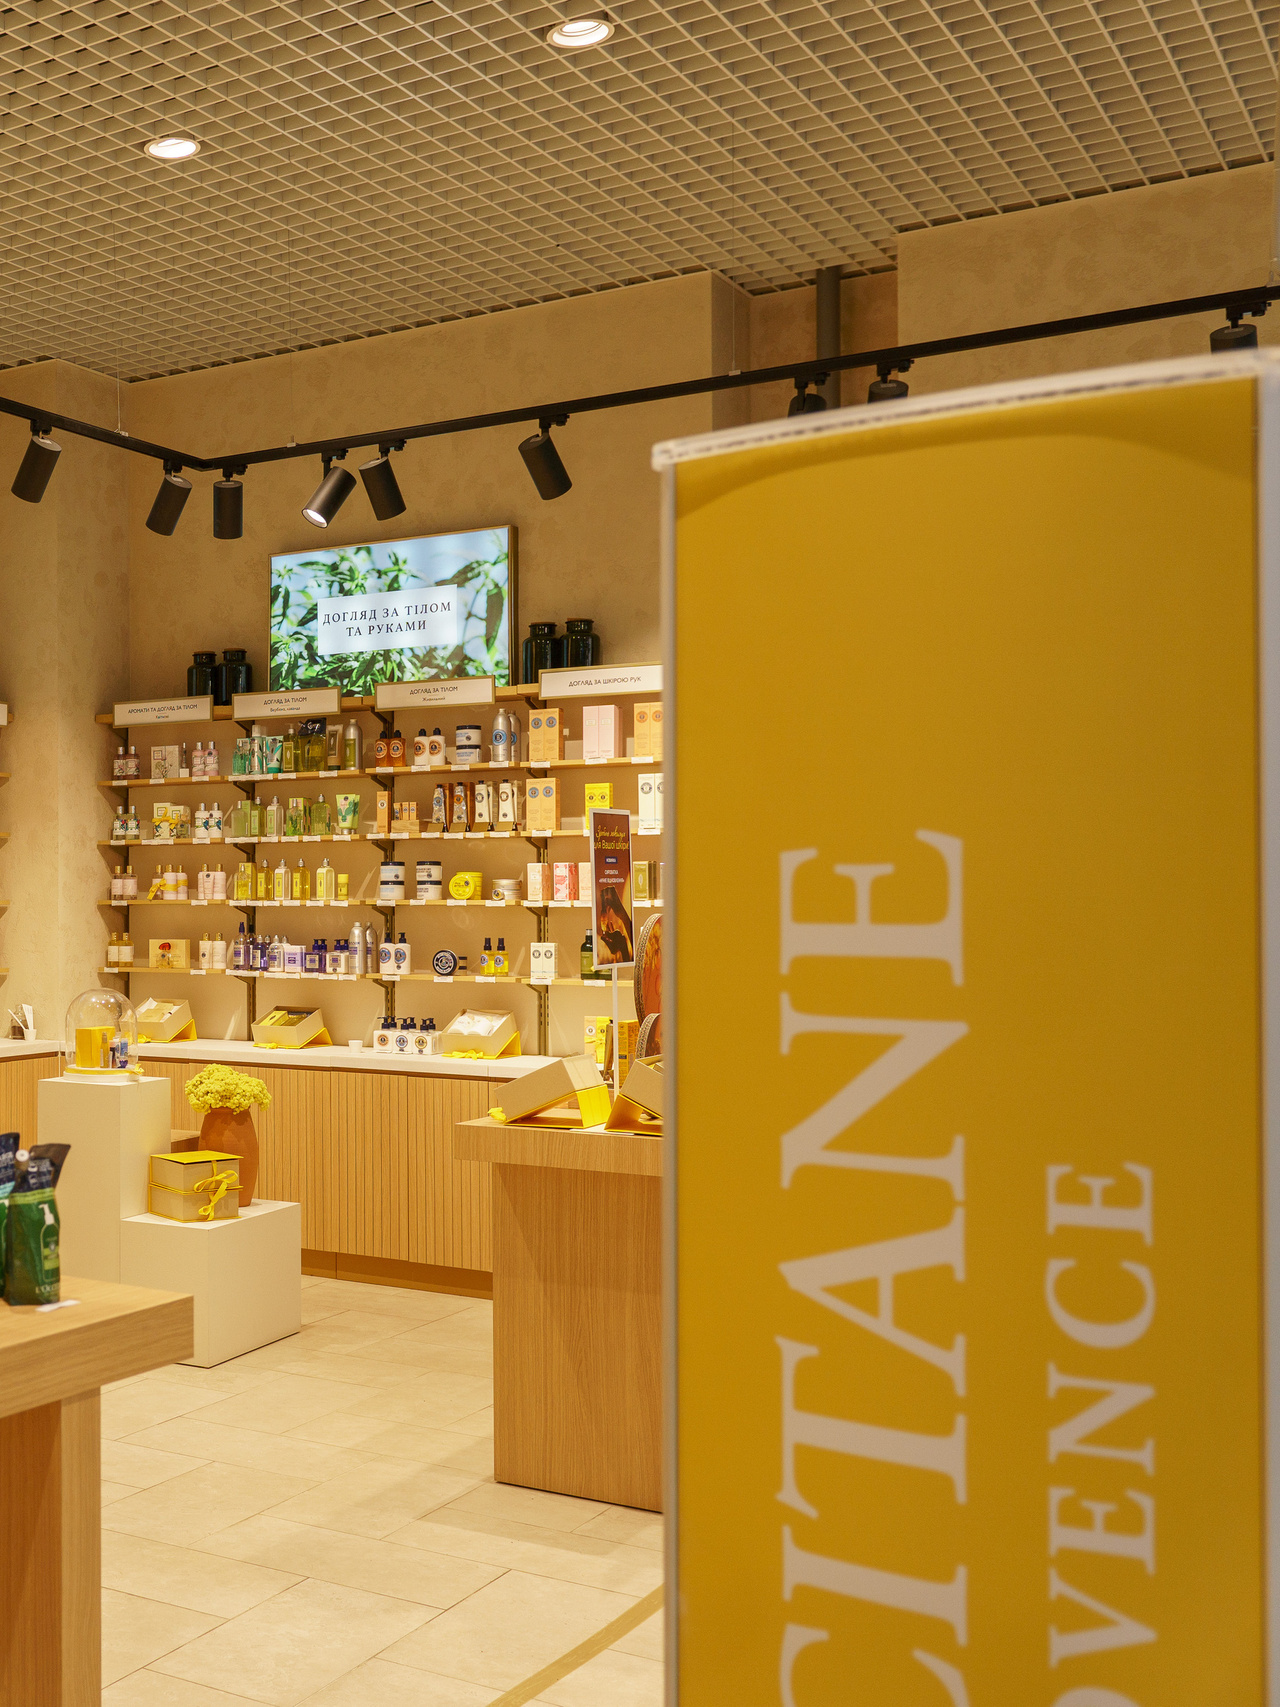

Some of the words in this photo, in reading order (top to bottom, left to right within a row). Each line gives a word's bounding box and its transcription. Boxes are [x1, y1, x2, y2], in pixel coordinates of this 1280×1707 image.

[322, 609, 377, 626] ДОГЛЯД
[382, 607, 399, 618] ЗА
[405, 601, 451, 616] ТІЛОМ
[346, 627, 362, 637] ТА
[368, 620, 427, 635] РУКАМИ
[602, 677, 629, 685] ШКІРОЮ
[1045, 1162, 1159, 1707] VENCE
